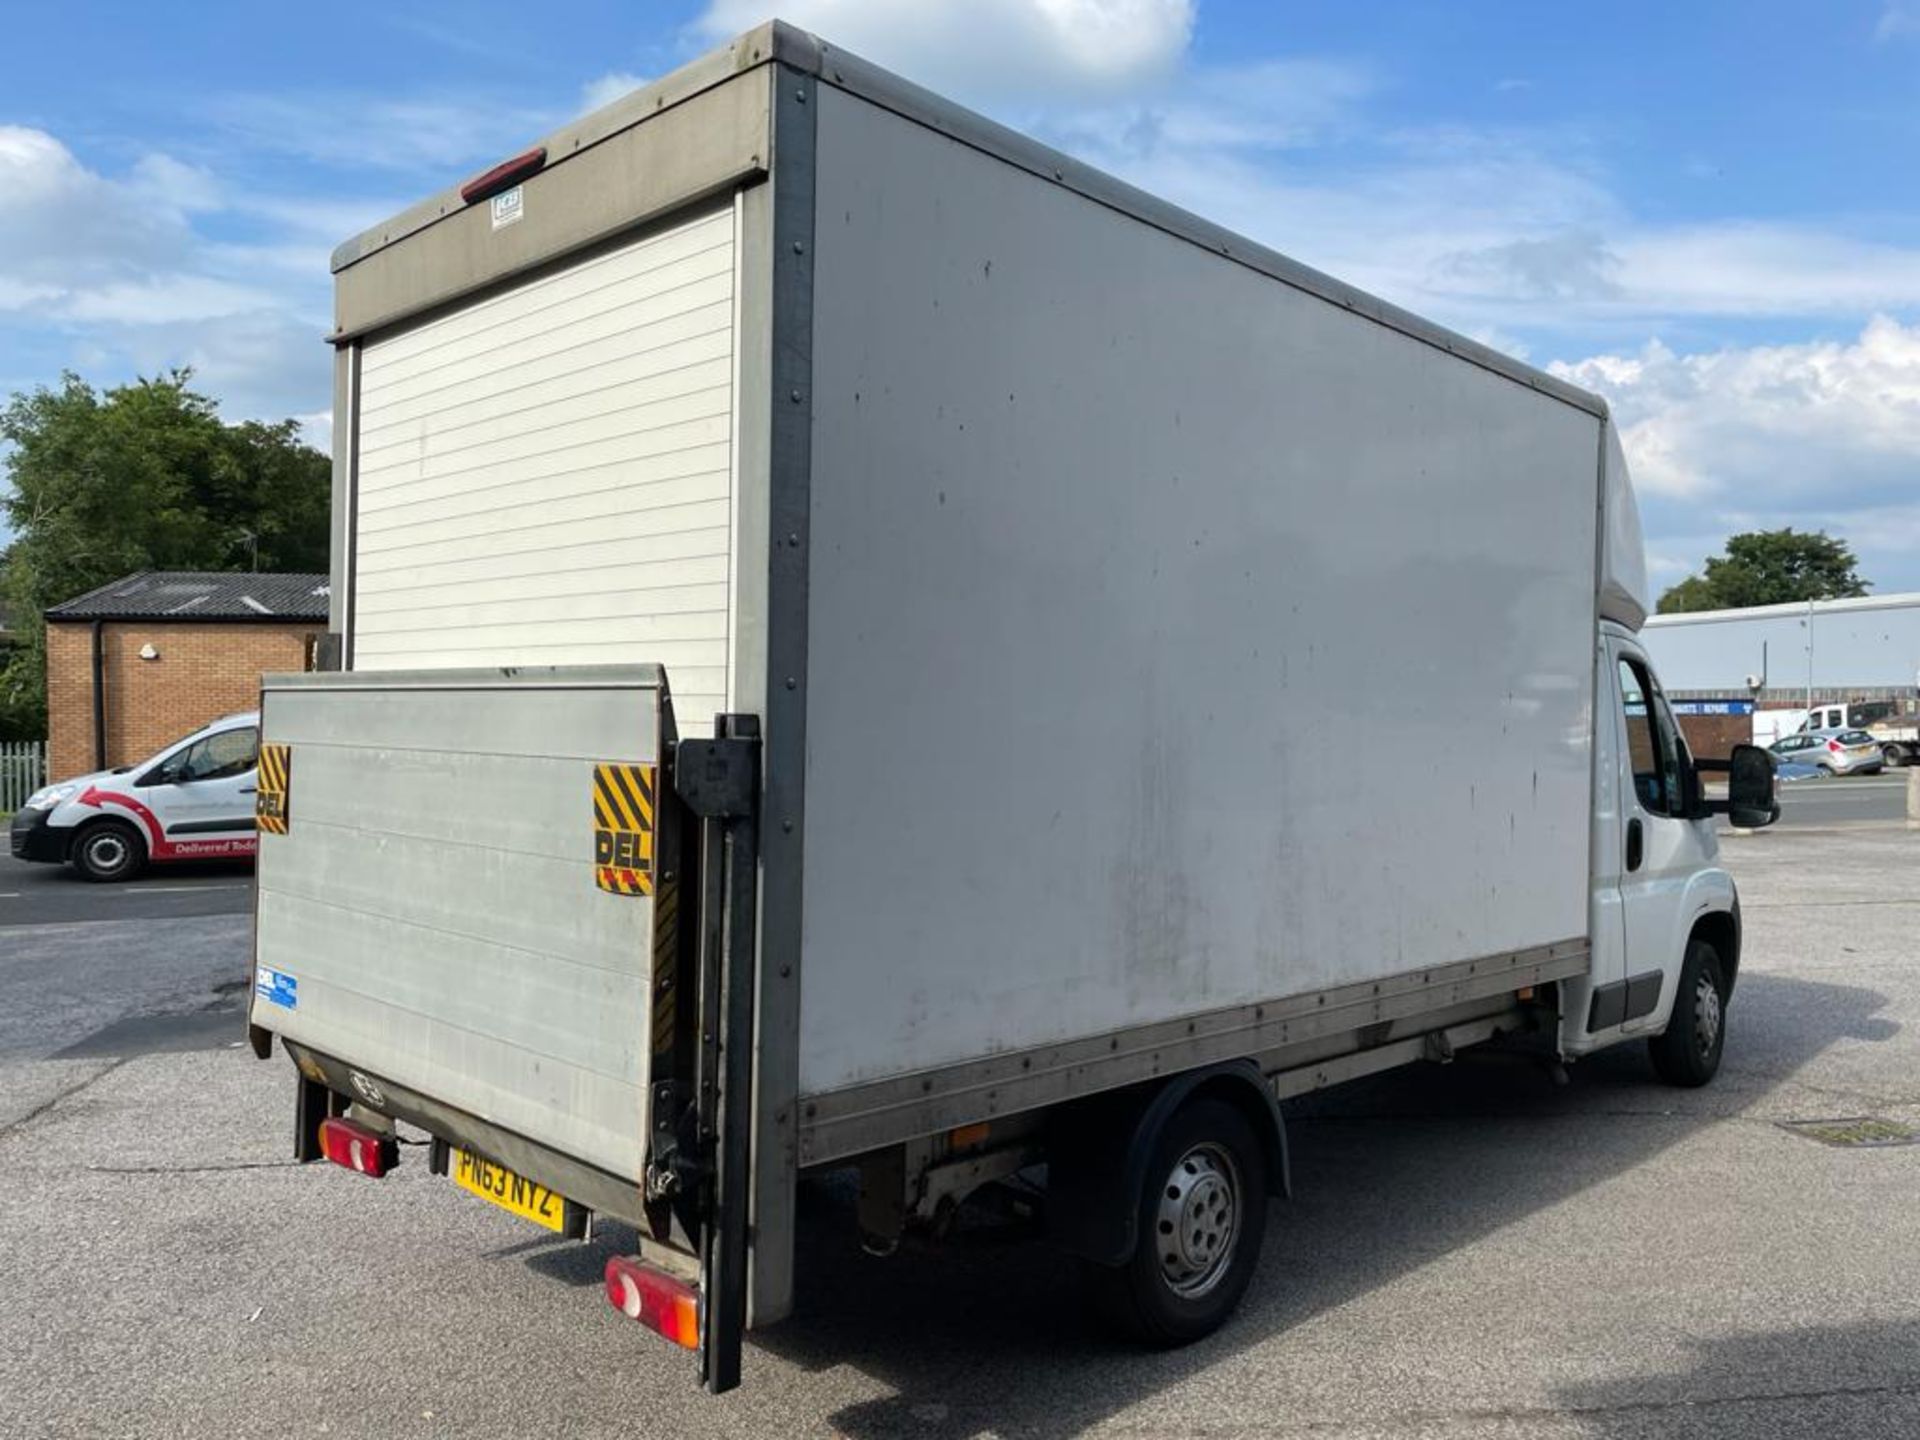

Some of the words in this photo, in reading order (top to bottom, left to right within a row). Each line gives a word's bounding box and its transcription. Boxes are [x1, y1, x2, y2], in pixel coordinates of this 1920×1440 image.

[257, 792, 283, 817] DEL
[175, 841, 229, 854] Delivered
[596, 831, 649, 870] DEL
[461, 1149, 506, 1197] PN63
[512, 1172, 552, 1218] NYZ
